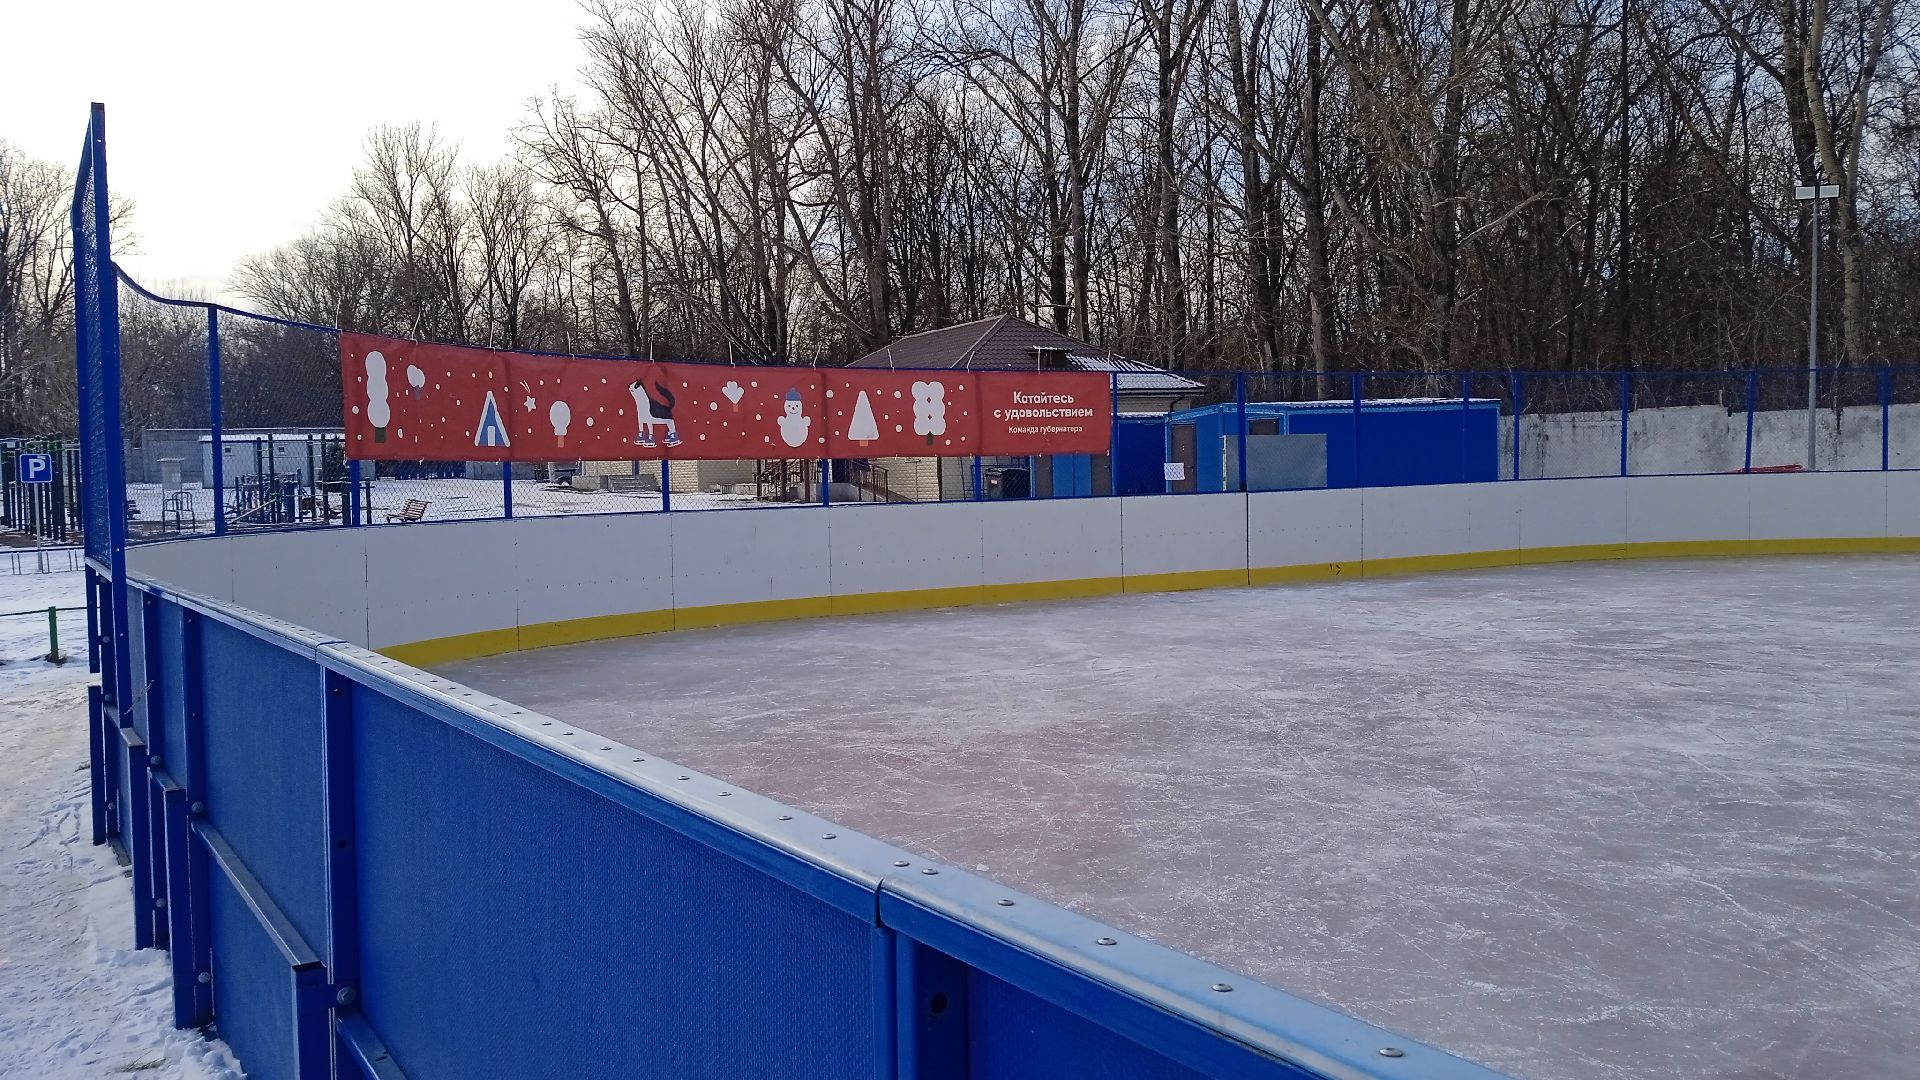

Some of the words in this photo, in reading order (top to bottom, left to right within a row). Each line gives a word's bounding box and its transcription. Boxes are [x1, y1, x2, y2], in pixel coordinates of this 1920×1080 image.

[1013, 391, 1074, 404] Катайтесь
[994, 409, 1001, 418] с
[1005, 408, 1093, 421] удовольствием
[1008, 425, 1038, 434] Команда
[1040, 425, 1083, 435] губернатора
[28, 458, 46, 479] P
